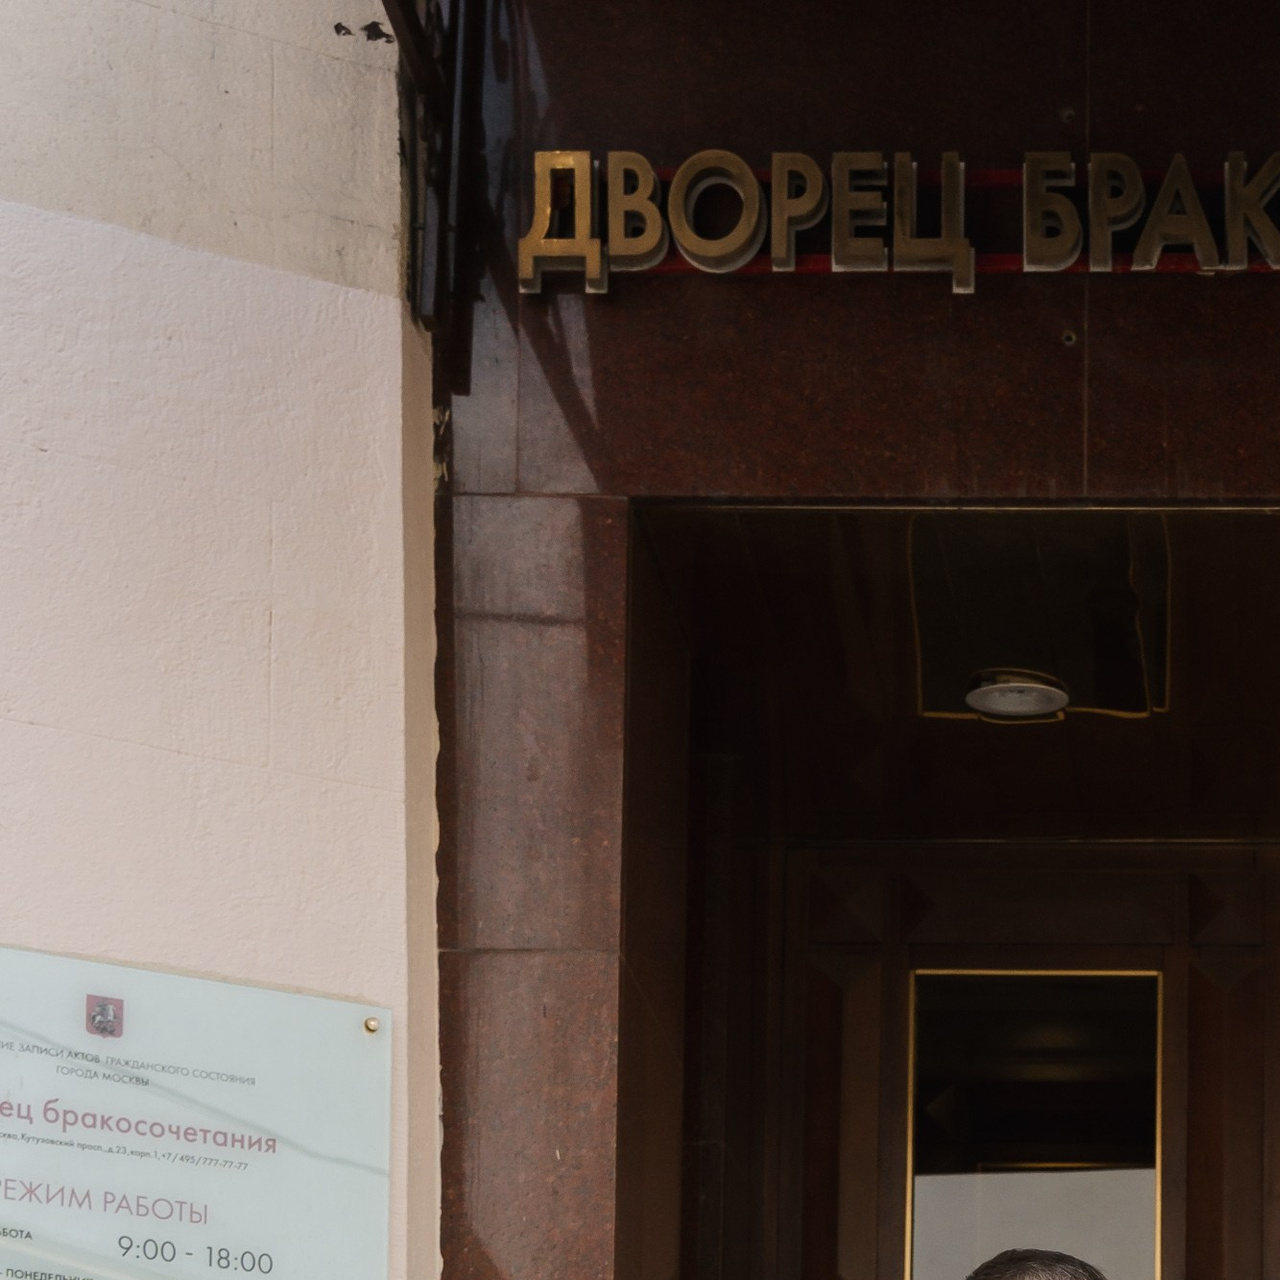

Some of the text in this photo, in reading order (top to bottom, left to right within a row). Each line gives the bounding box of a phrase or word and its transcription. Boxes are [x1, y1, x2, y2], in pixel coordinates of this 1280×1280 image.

[518, 149, 975, 294] ДВОРЕЦ
[18, 1043, 64, 1058] ЗАПИСИ
[67, 1050, 101, 1063] АКТОВ
[105, 1056, 190, 1076] ГРАЖДАНСКОГО
[191, 1069, 256, 1086] СОСТОЯНИЯ
[56, 1065, 150, 1086] ГОРОДА МОСКВЫ
[42, 1098, 277, 1153] бракосочетания
[0, 1178, 208, 1225] ЕЖИМ РАБОТЫ
[0, 1227, 33, 1240] БОТА
[118, 1235, 177, 1263] 9:00
[206, 1246, 273, 1274] 18:00
